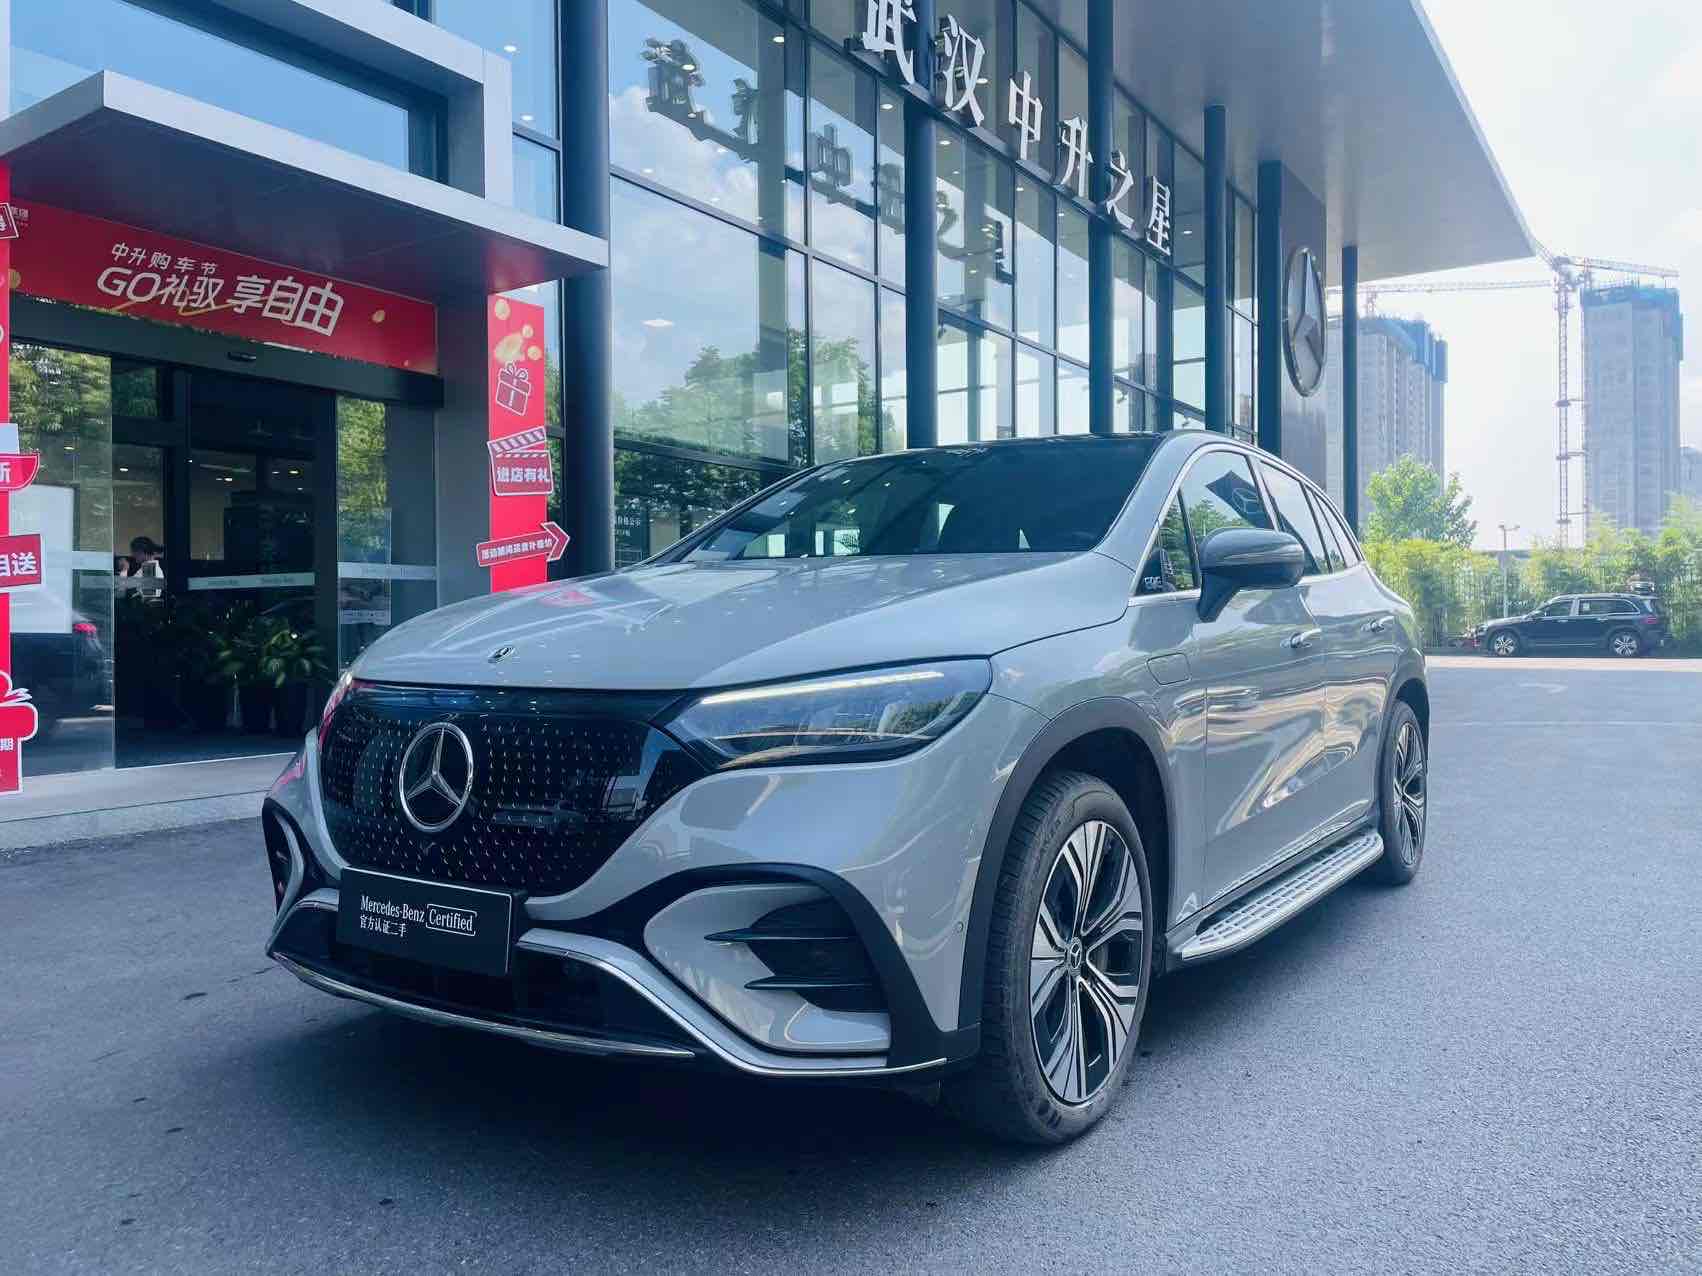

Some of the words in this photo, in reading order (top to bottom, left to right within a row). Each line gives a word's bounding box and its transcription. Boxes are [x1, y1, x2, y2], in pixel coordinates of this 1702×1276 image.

[111, 242, 218, 275] 中升购车节
[227, 275, 345, 336] 享自由
[360, 895, 425, 923] Mercedes-Benz
[429, 908, 473, 931] Certified
